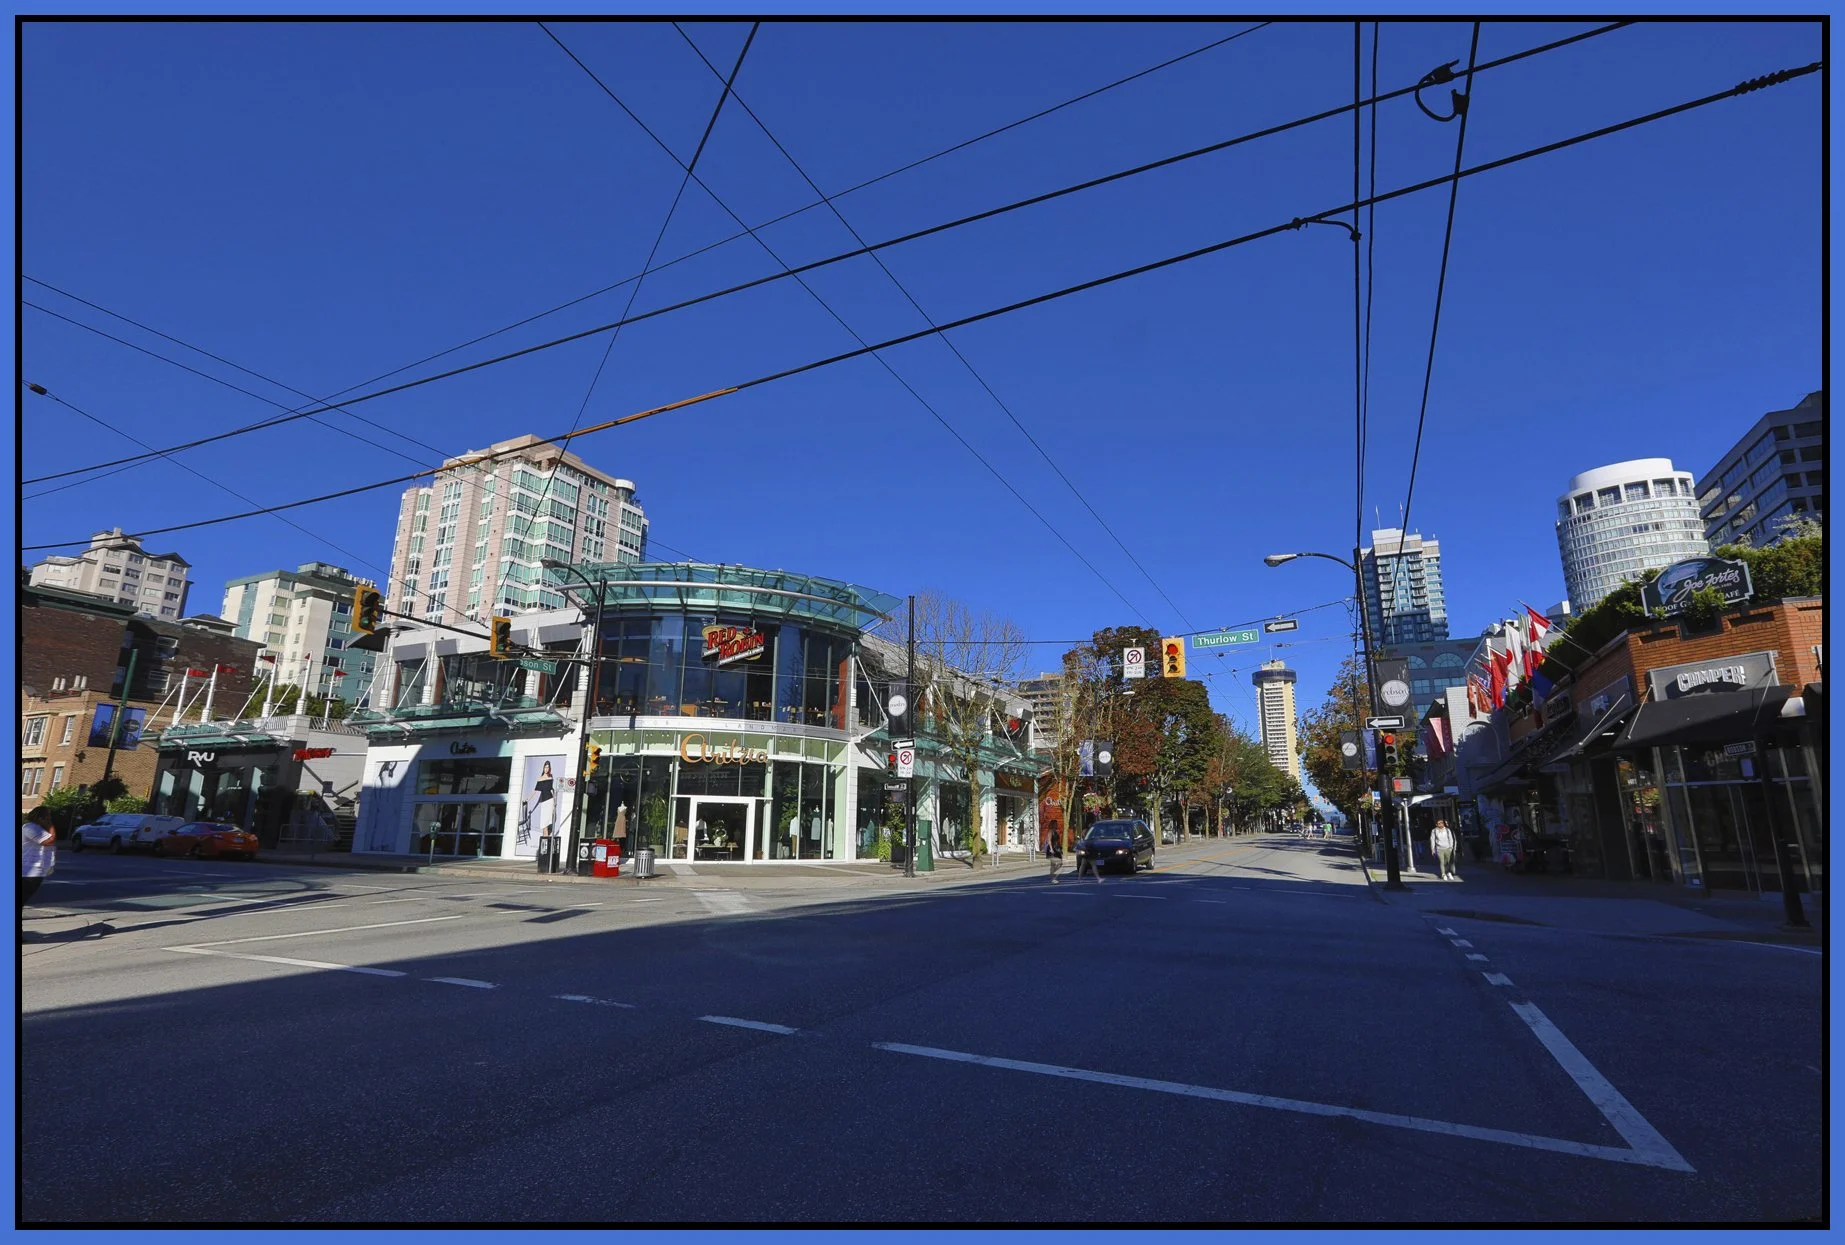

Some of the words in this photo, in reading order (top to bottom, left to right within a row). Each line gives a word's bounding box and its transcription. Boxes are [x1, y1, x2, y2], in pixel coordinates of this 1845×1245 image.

[1673, 580, 1704, 602] Joe
[1700, 568, 1740, 592] Fortes
[1656, 603, 1678, 613] OOF
[707, 627, 737, 649] RED
[719, 633, 765, 658] ROBIN
[1198, 635, 1237, 645] Thurlow
[1242, 632, 1254, 641] St
[1677, 666, 1746, 692] CAMPER
[187, 751, 215, 767] RYU
[681, 733, 768, 765] Aritzia
